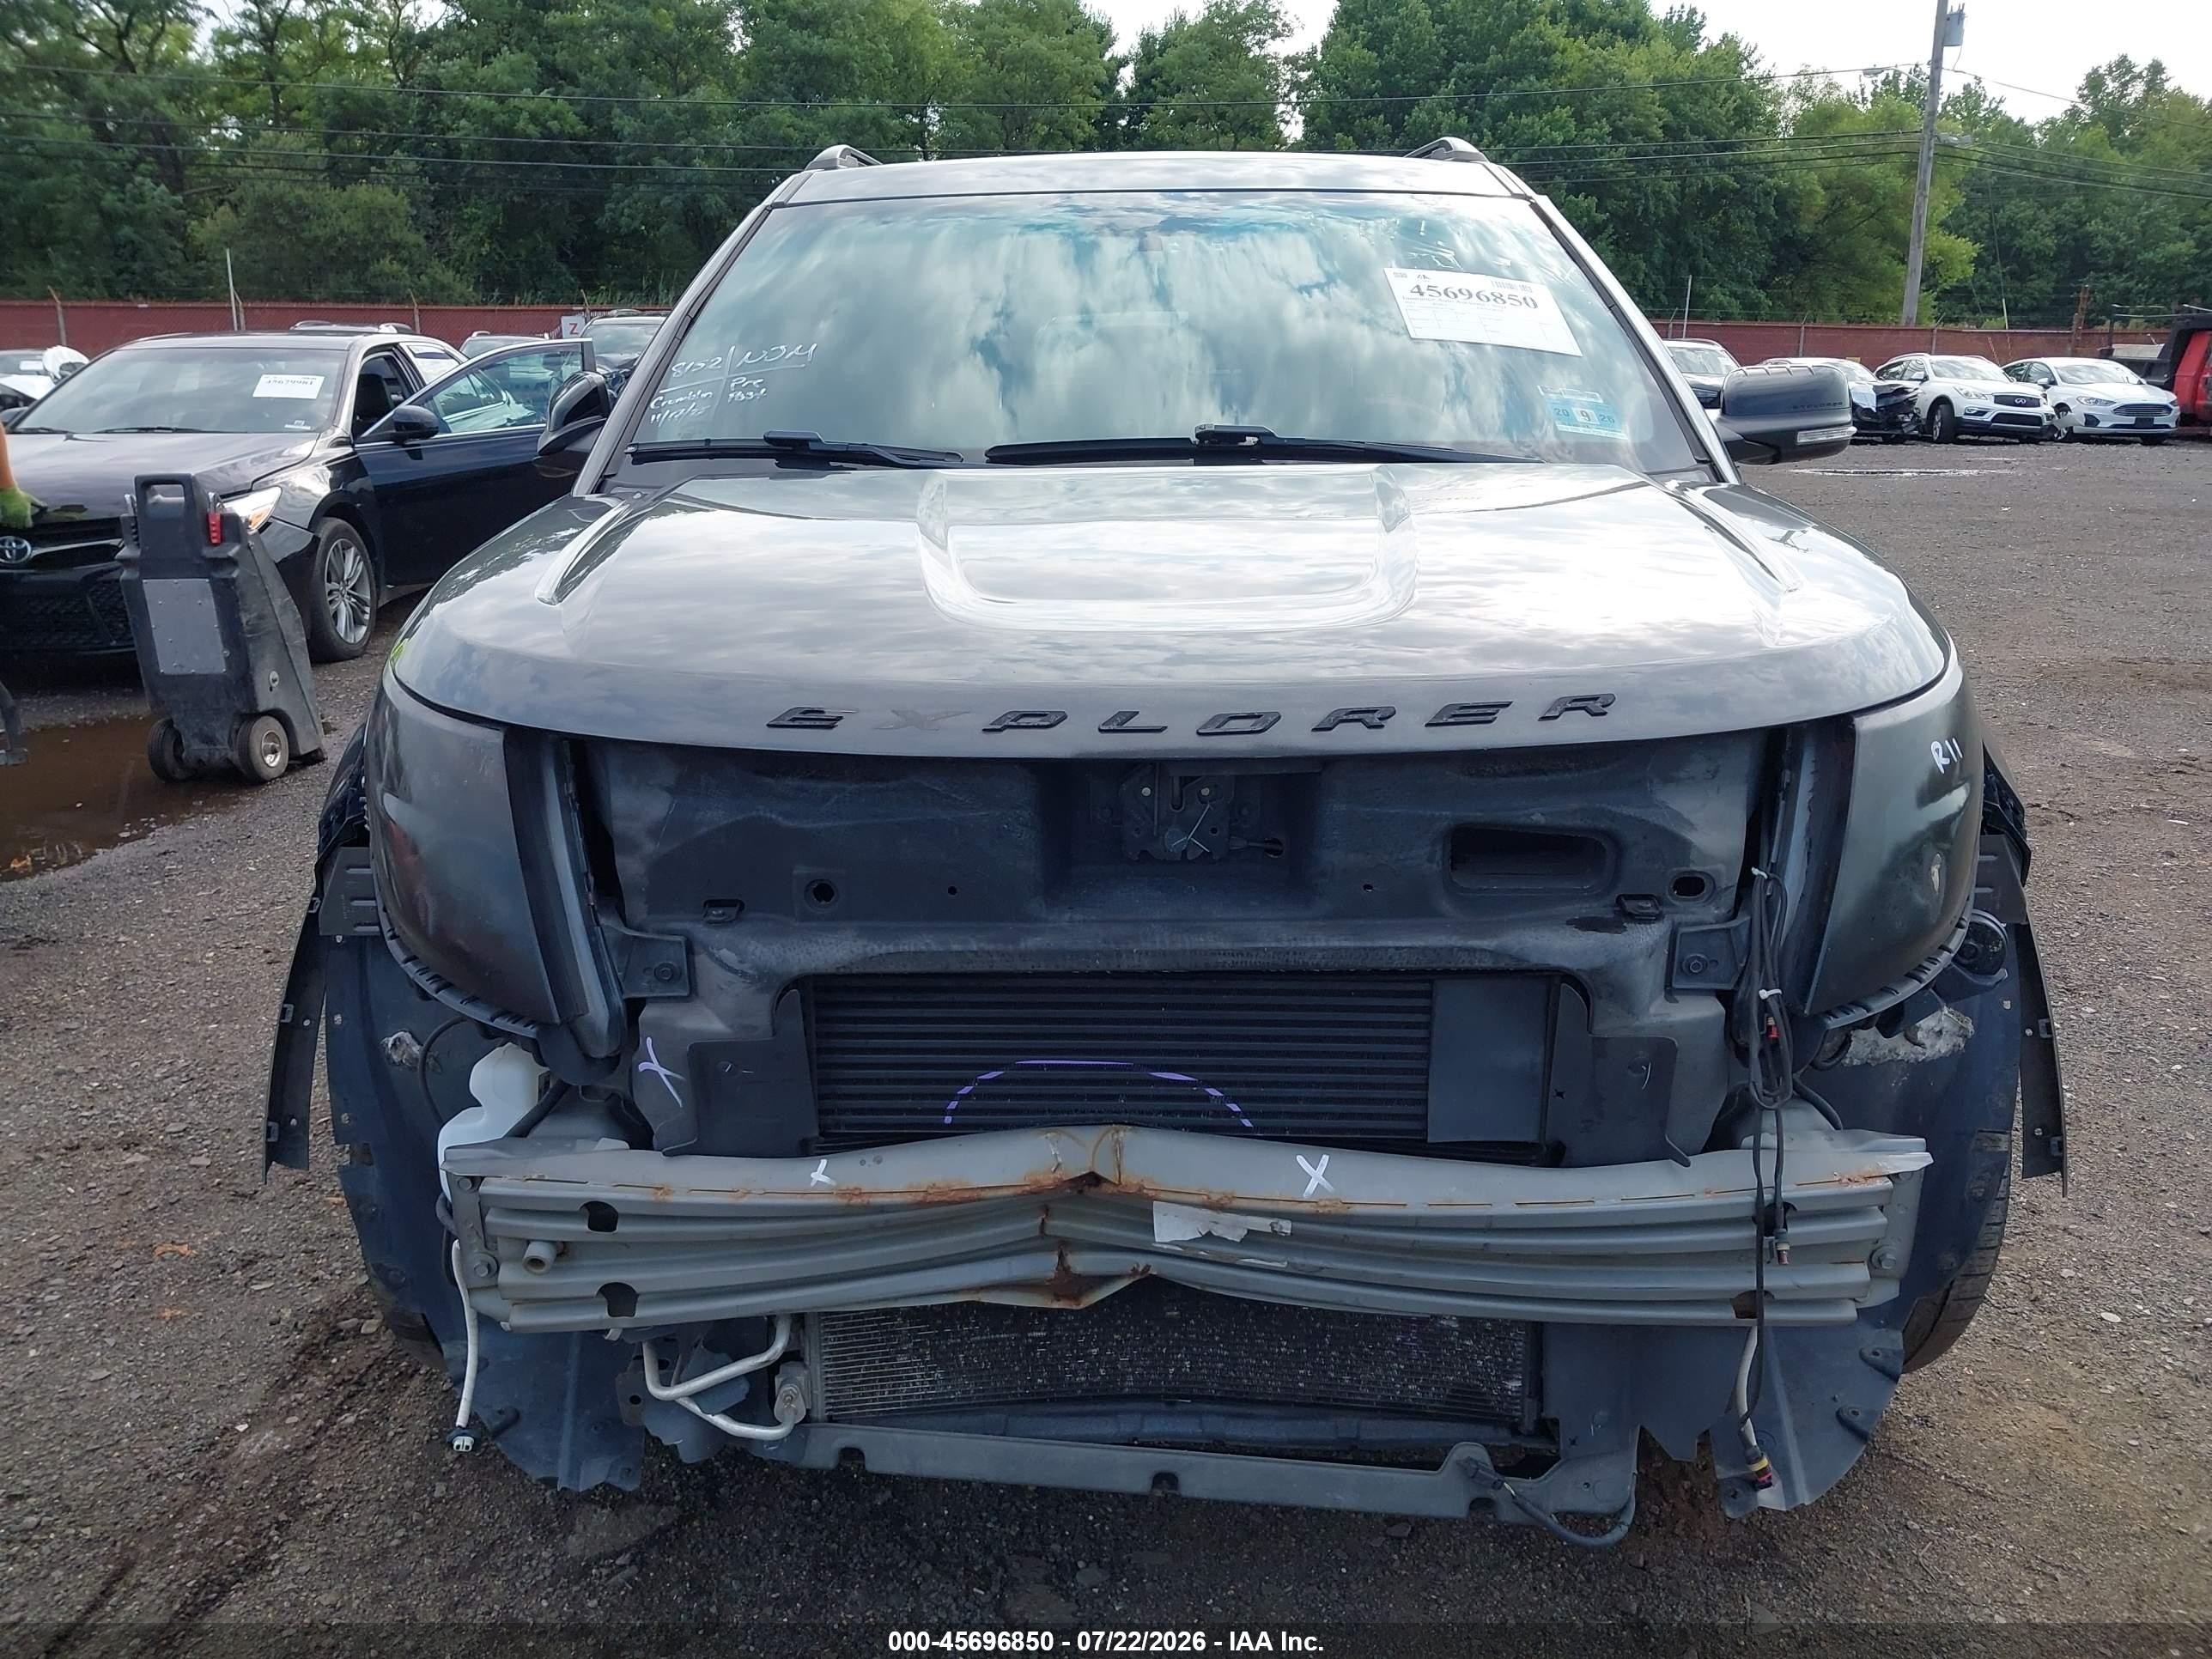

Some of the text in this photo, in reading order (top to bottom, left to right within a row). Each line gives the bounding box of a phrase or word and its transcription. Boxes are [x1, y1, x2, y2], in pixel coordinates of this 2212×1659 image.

[1410, 284, 1538, 309] 45696850
[569, 323, 579, 335] Z
[1580, 410, 1591, 422] 9
[767, 693, 1616, 735] EXPLORER
